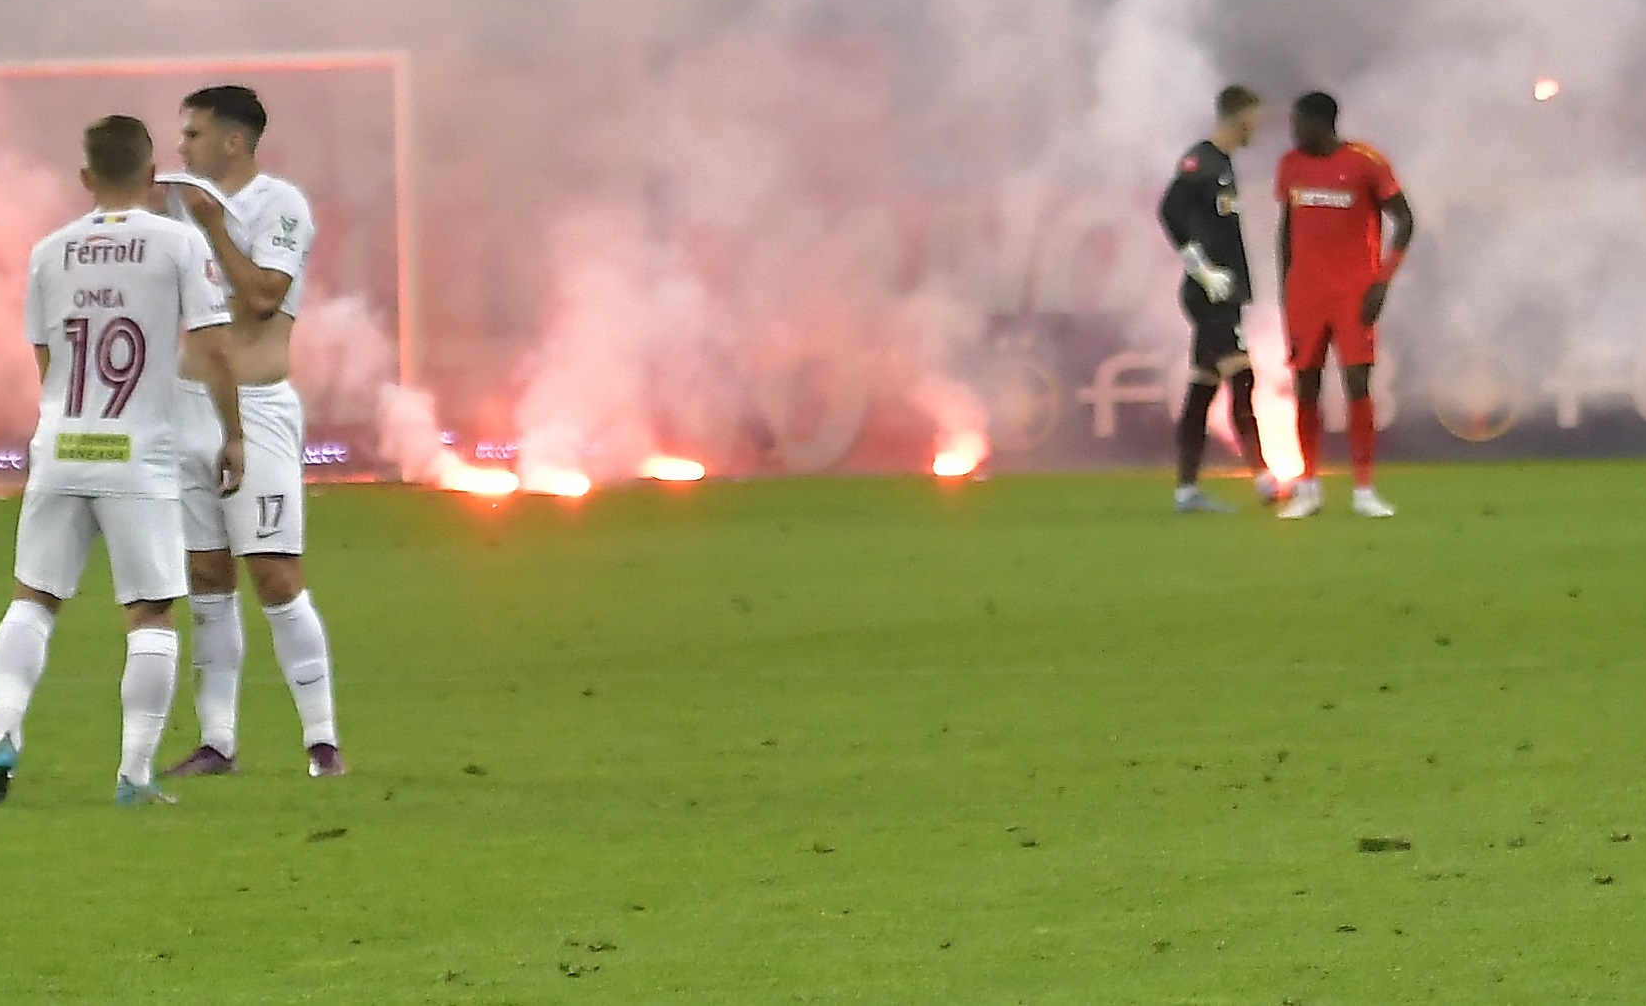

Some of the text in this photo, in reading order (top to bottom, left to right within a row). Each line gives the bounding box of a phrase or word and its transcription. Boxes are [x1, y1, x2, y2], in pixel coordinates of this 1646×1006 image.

[63, 237, 147, 271] Ferroli
[73, 288, 125, 308] ONEA
[63, 316, 147, 419] 19
[256, 494, 285, 528] 17
